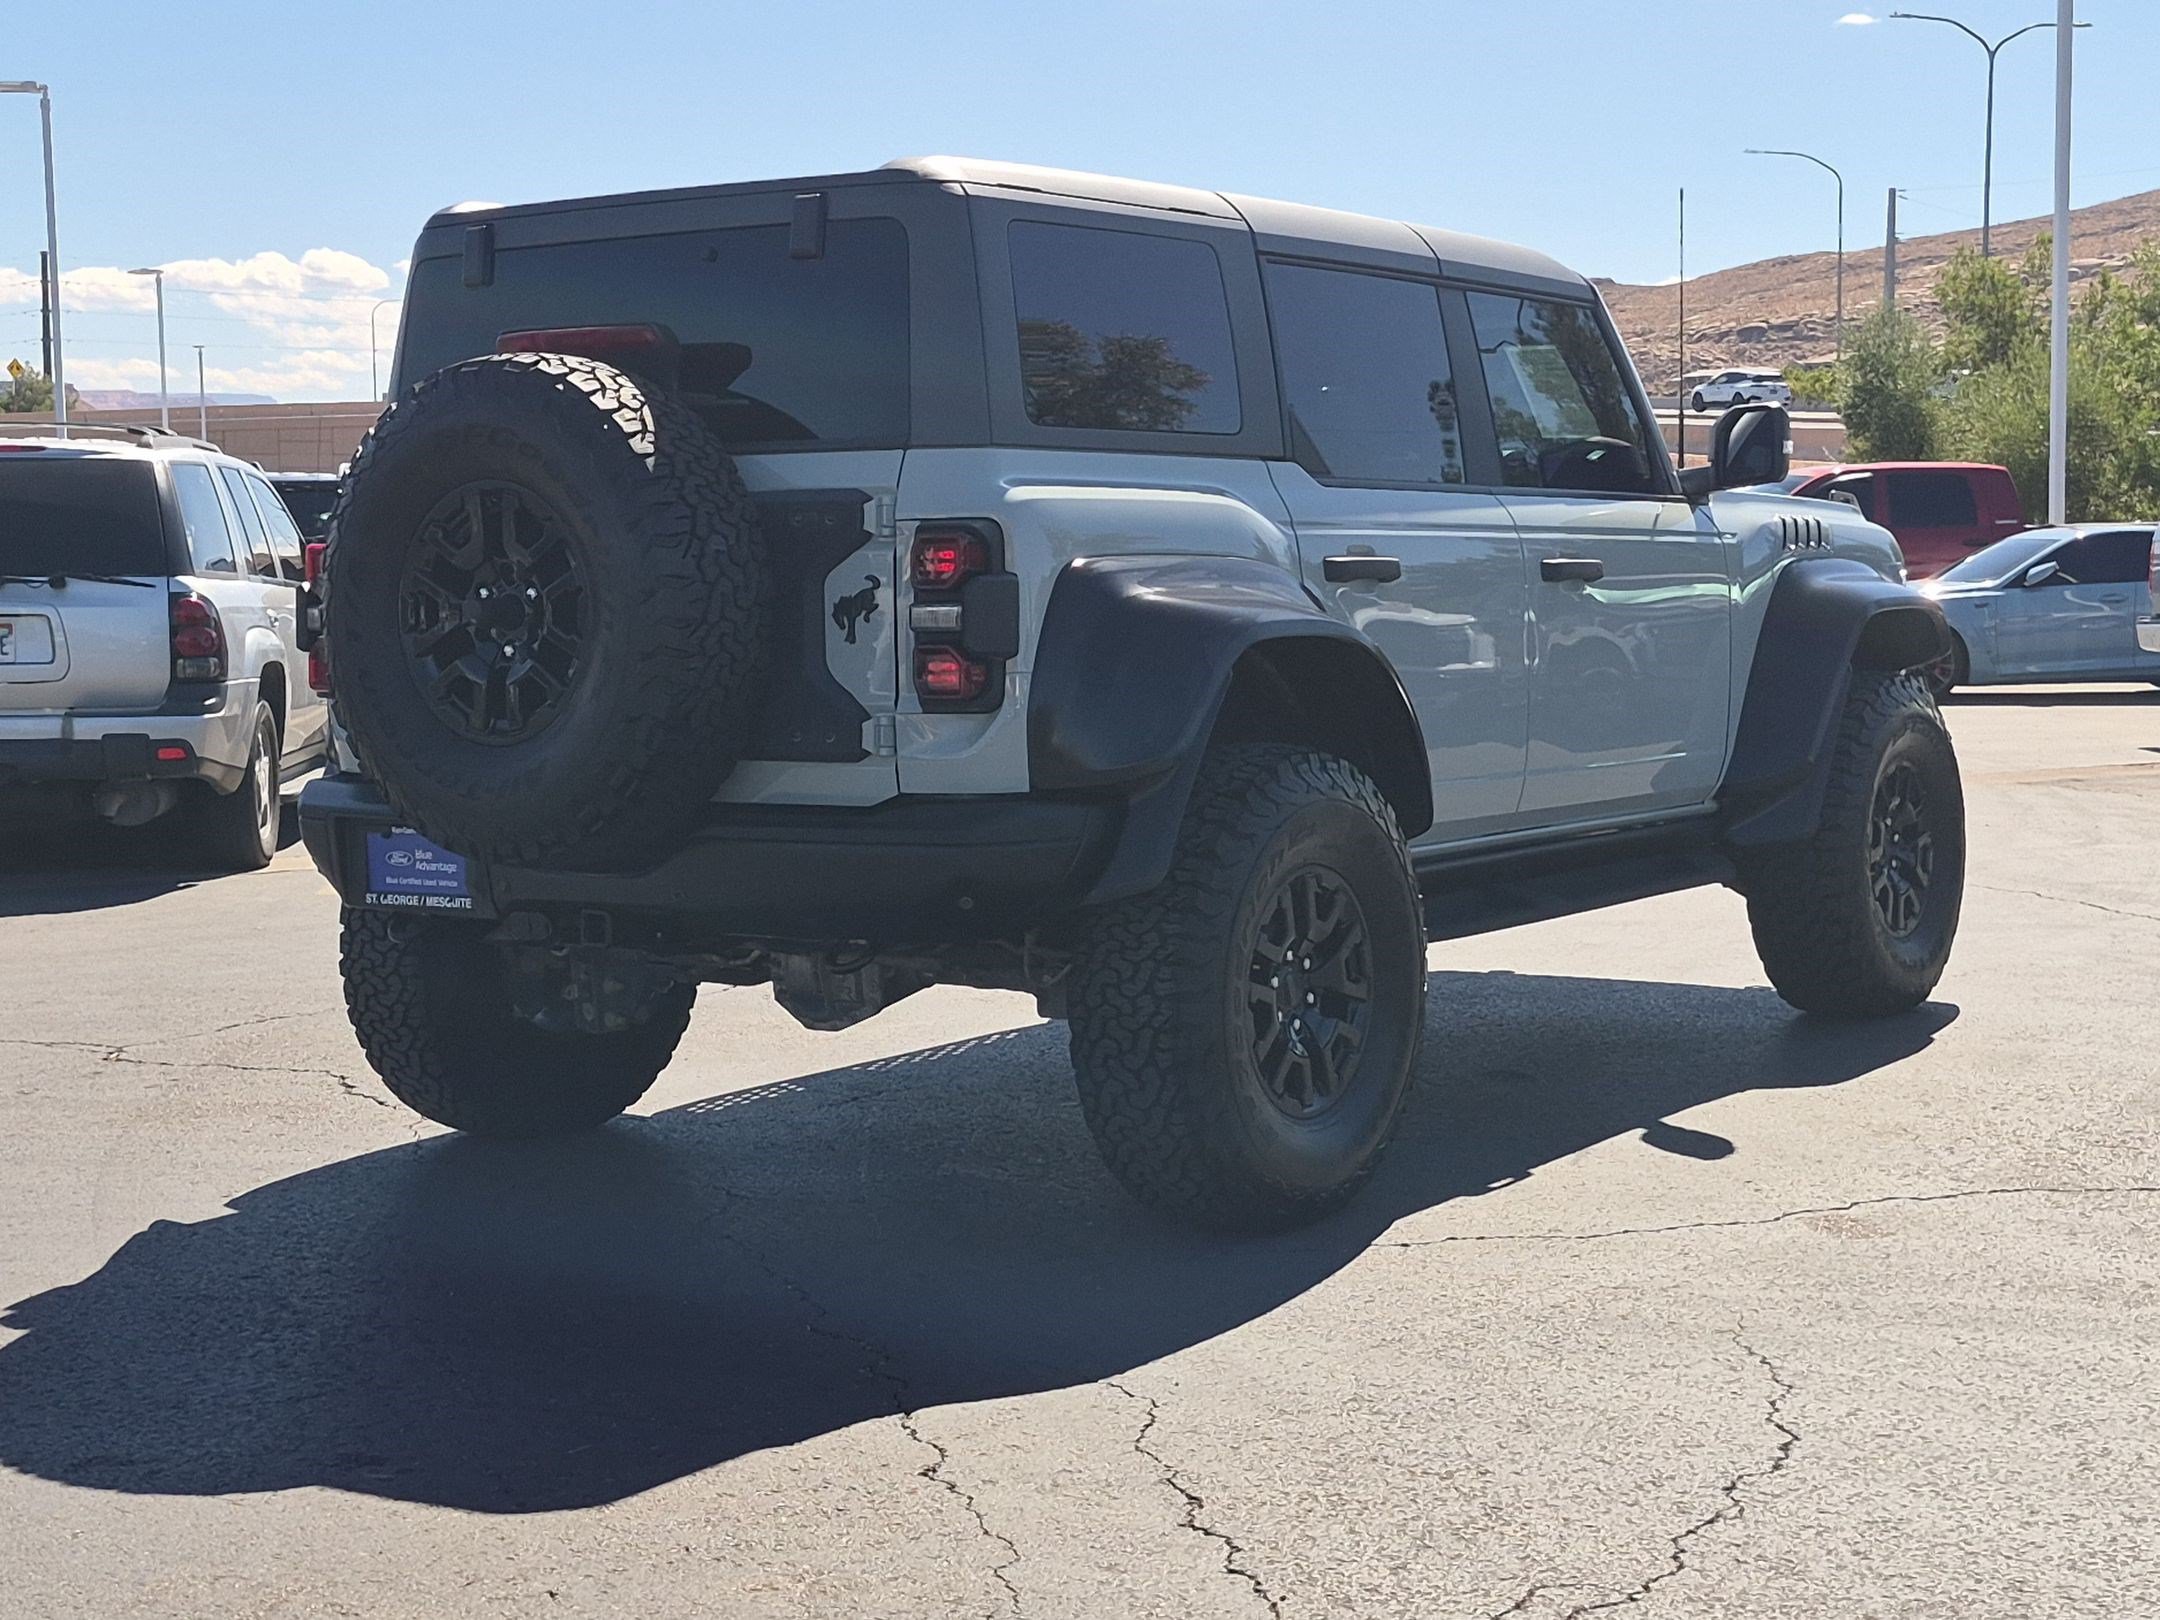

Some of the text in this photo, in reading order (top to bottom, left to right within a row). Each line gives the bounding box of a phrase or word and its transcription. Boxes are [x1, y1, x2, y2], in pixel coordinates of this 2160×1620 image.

[415, 849, 433, 860] Blue
[415, 862, 457, 874] Advantage
[366, 893, 379, 904] ST.
[380, 894, 419, 906] GEORGE
[426, 897, 472, 909] MESQUITE
